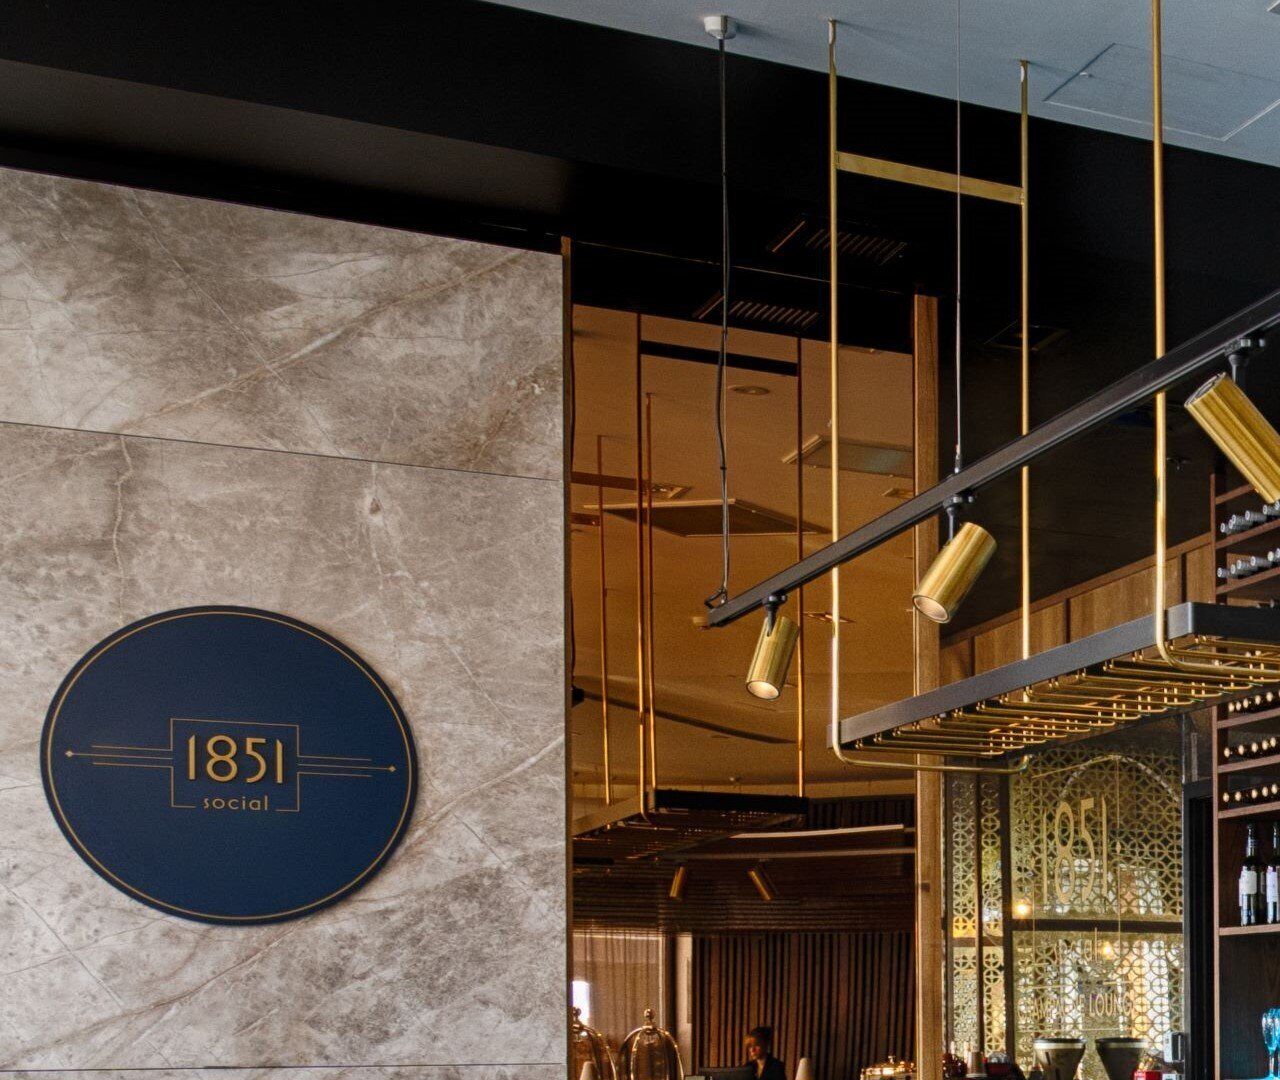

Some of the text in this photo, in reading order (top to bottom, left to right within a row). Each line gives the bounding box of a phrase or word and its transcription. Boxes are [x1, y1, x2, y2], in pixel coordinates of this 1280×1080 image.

[187, 734, 285, 784] 1851
[203, 795, 269, 811] social
[1042, 797, 1109, 904] 1851
